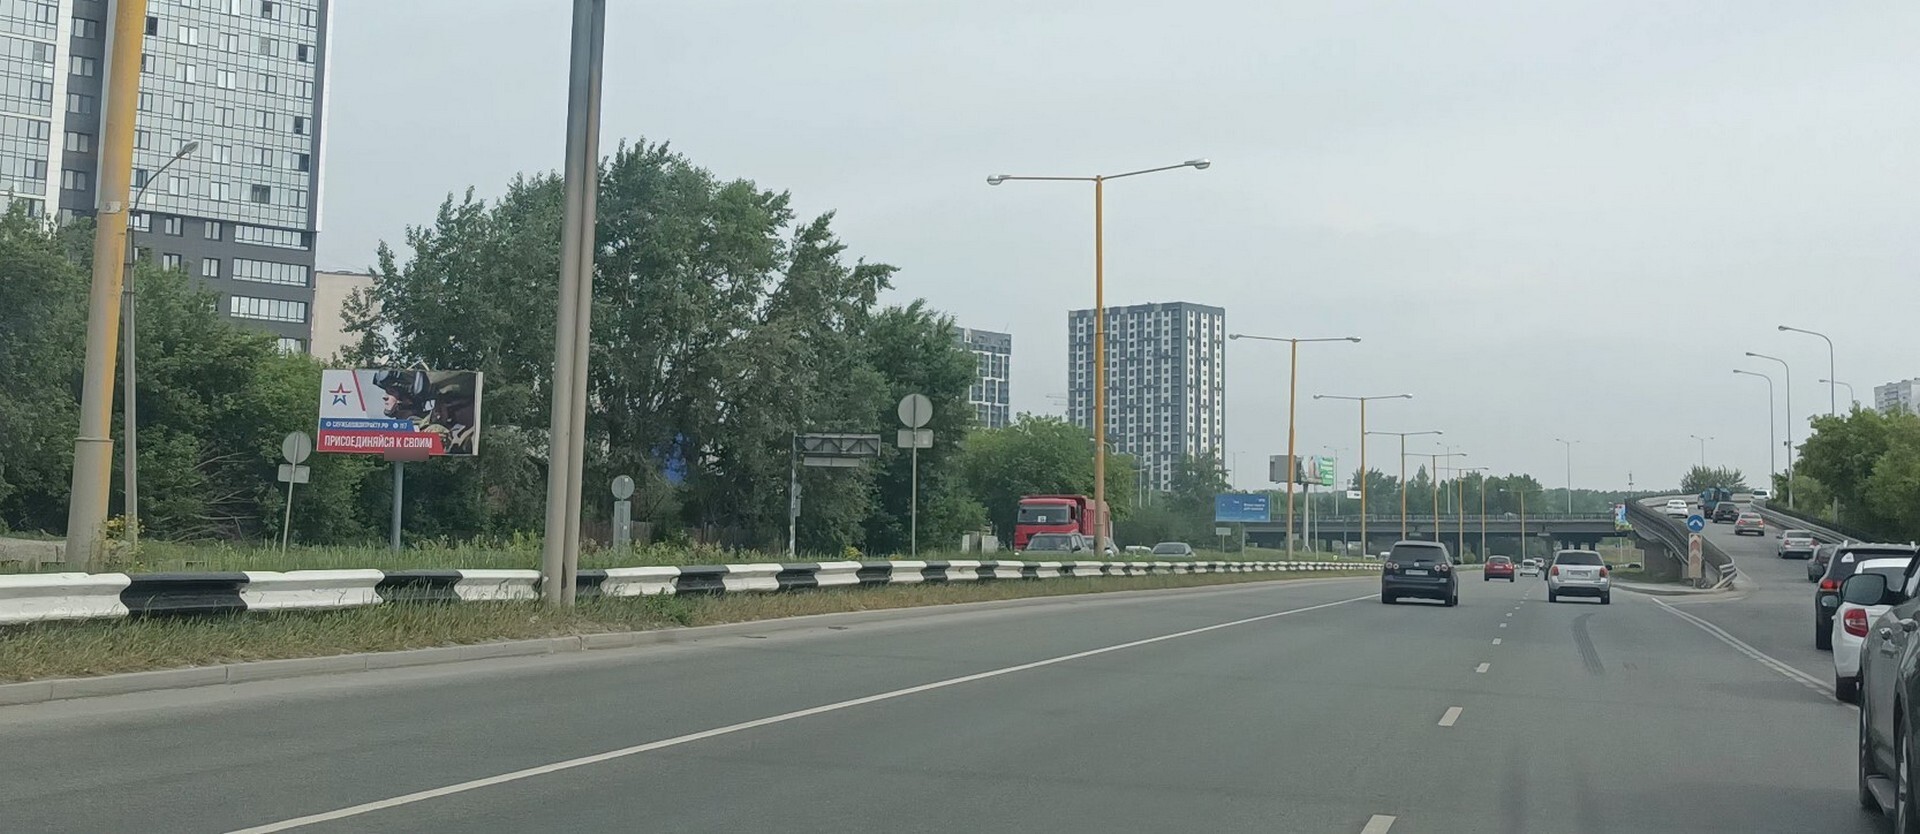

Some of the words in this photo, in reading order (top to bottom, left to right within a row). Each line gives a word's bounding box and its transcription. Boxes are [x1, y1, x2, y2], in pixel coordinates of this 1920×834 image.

[324, 434, 395, 448] ПРИСОЕДИНЯЙСЯ
[396, 438, 402, 447] К
[403, 438, 432, 448] СВОИМ
